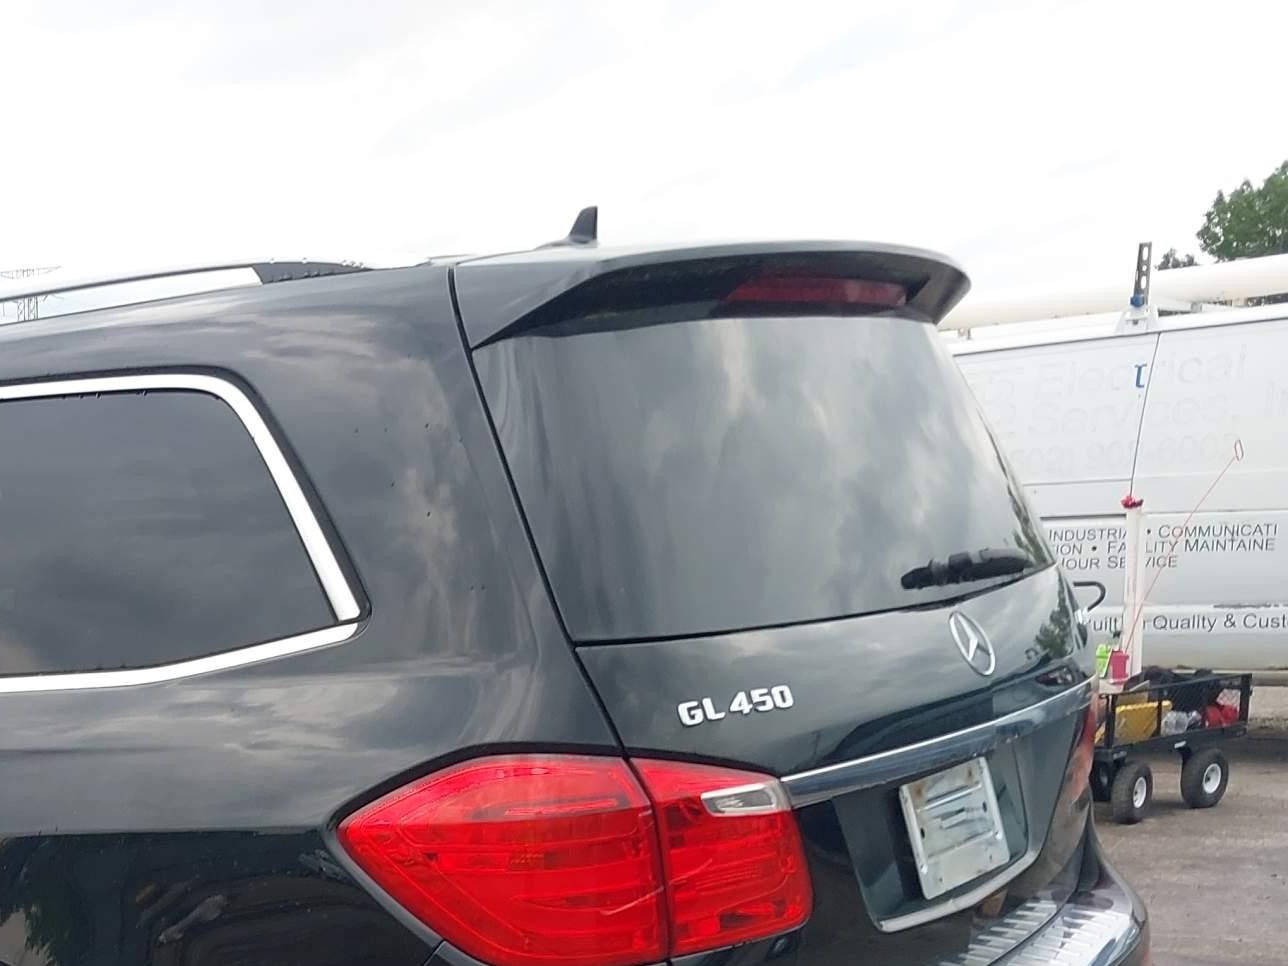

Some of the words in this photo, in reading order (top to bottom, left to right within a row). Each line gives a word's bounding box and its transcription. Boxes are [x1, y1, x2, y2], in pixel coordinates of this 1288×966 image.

[1158, 523, 1278, 538] COMMUNICATI
[1184, 538, 1276, 552] MAINTAINE
[1153, 614, 1217, 633] Quality
[1223, 613, 1237, 629] &
[1243, 612, 1288, 629] Cust
[677, 697, 726, 727] GL
[729, 684, 795, 715] 450
